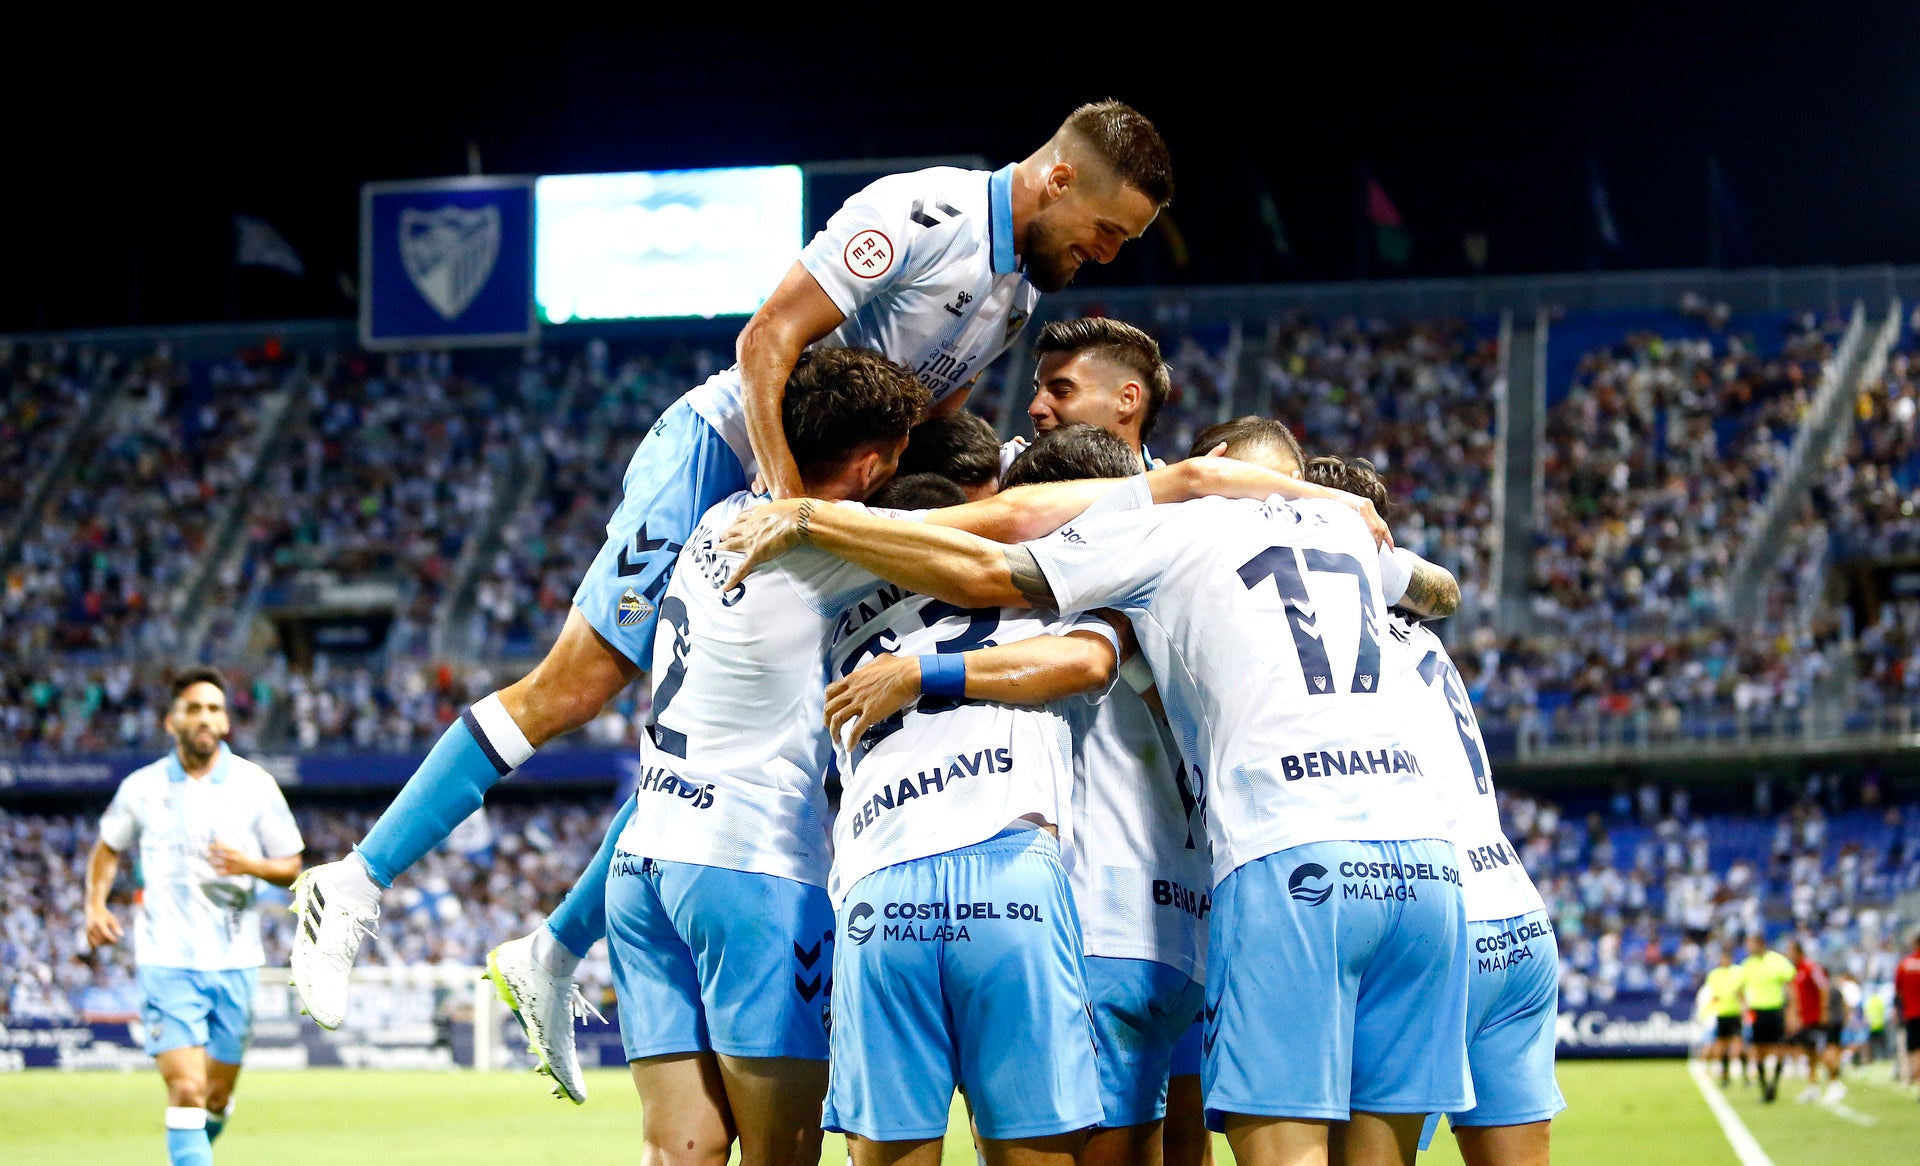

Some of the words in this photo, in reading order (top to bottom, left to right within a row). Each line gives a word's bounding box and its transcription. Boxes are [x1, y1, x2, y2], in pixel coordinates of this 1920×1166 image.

[1236, 545, 1381, 696] 17
[853, 747, 1013, 840] BENAHAVIS
[1339, 861, 1402, 880] COSTA
[1405, 863, 1439, 880] DEL
[1443, 865, 1463, 888] SOL
[1343, 879, 1417, 901] MÁLAGA
[883, 902, 951, 920] COSTA
[956, 902, 1000, 920] DEL
[1006, 902, 1043, 922] SOL
[883, 921, 971, 942] MÁLAGA
[1516, 921, 1547, 943] DEL
